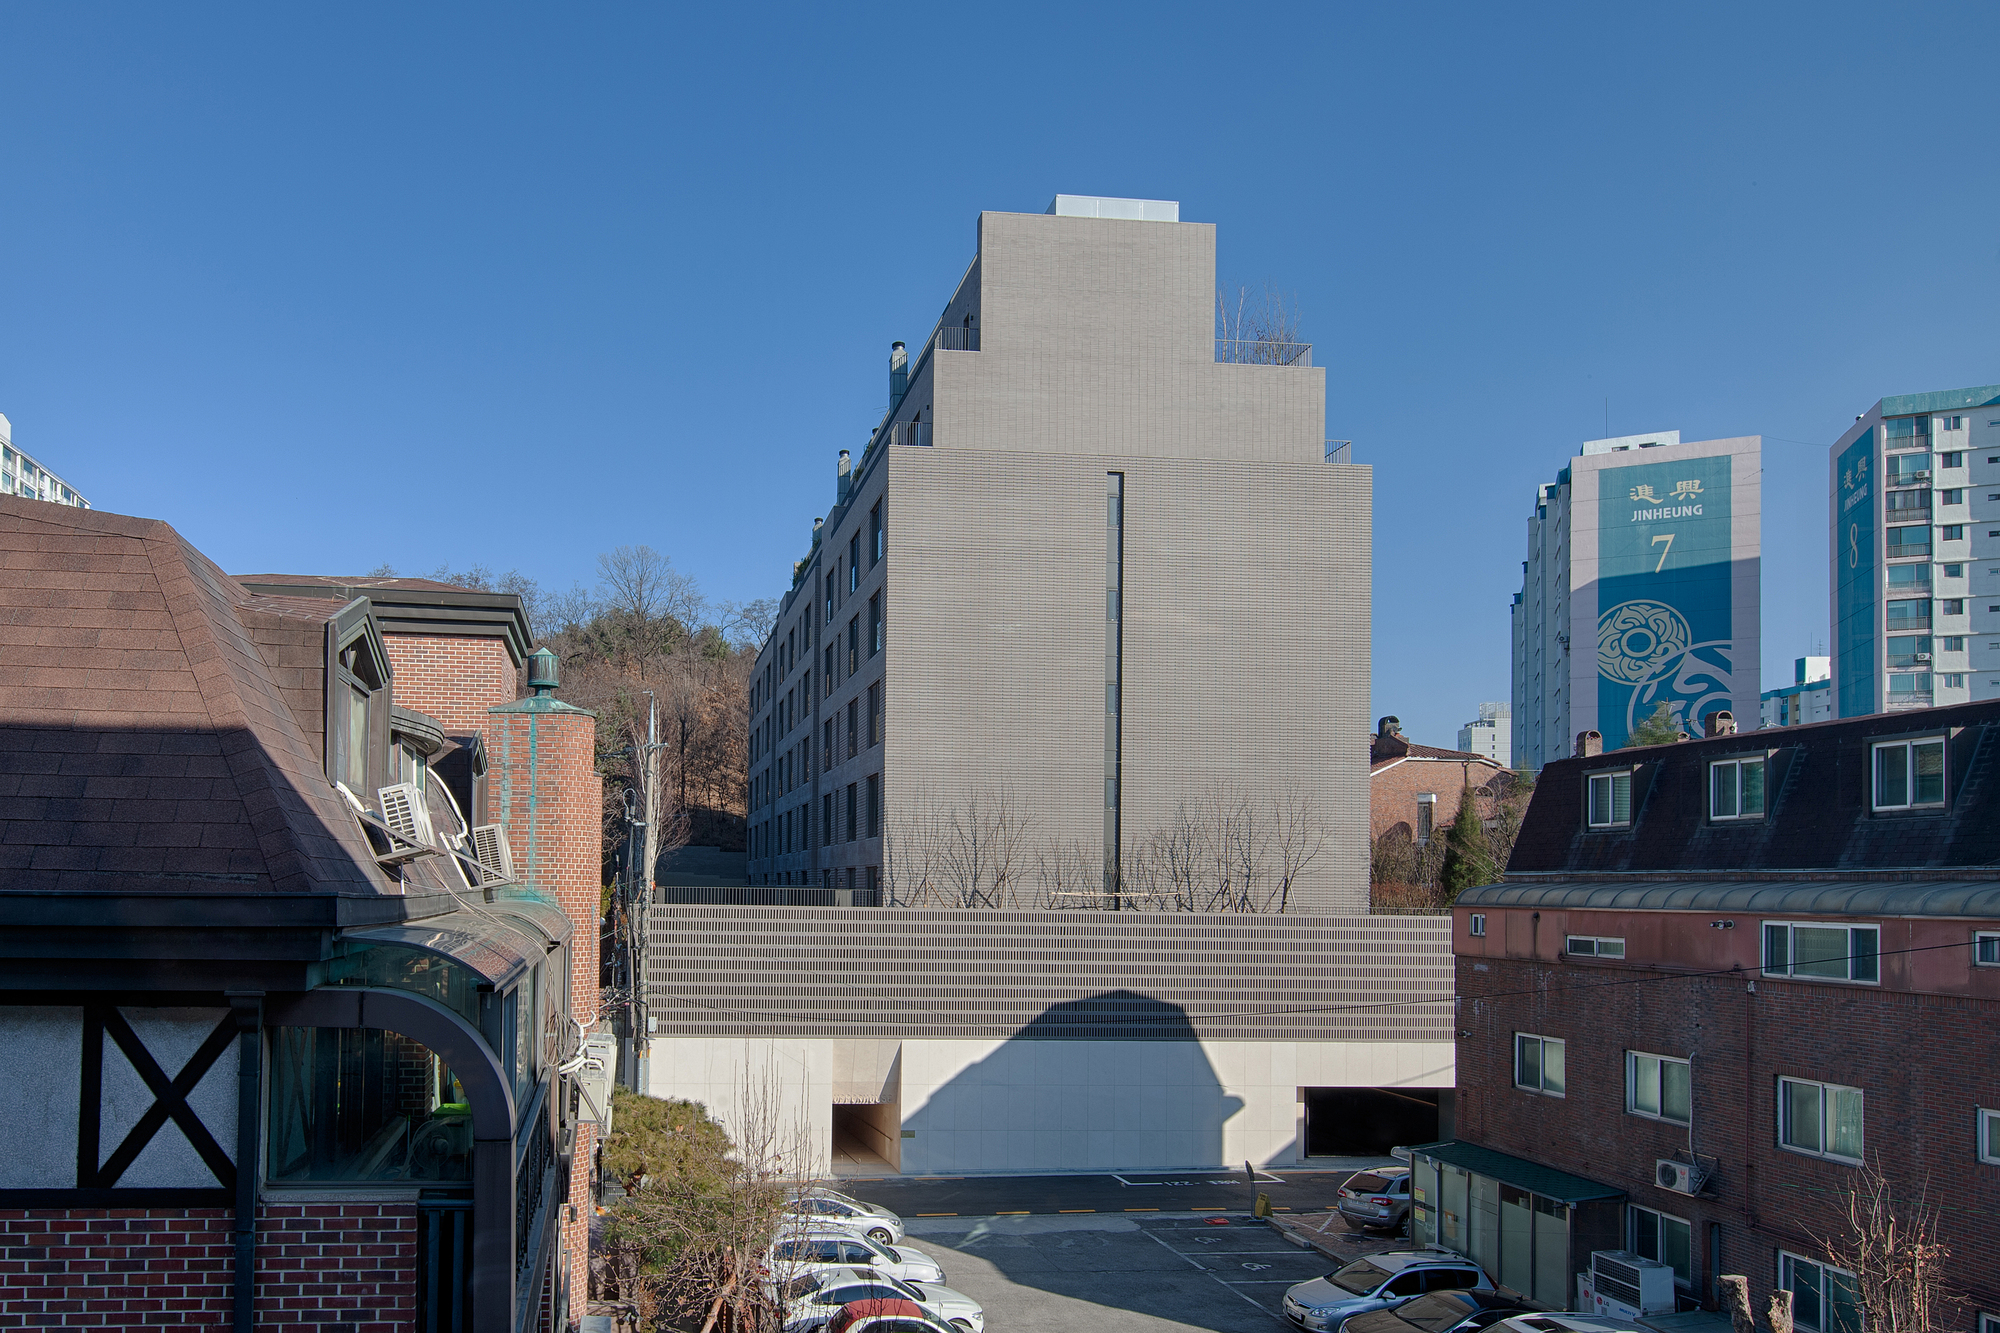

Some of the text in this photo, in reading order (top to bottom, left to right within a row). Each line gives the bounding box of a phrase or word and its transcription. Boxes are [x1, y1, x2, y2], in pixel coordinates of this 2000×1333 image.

[1631, 504, 1703, 522] JINHEUNG
[1844, 483, 1868, 512] JINHEUNG
[1651, 533, 1675, 573] 7
[1850, 522, 1858, 569] 8
